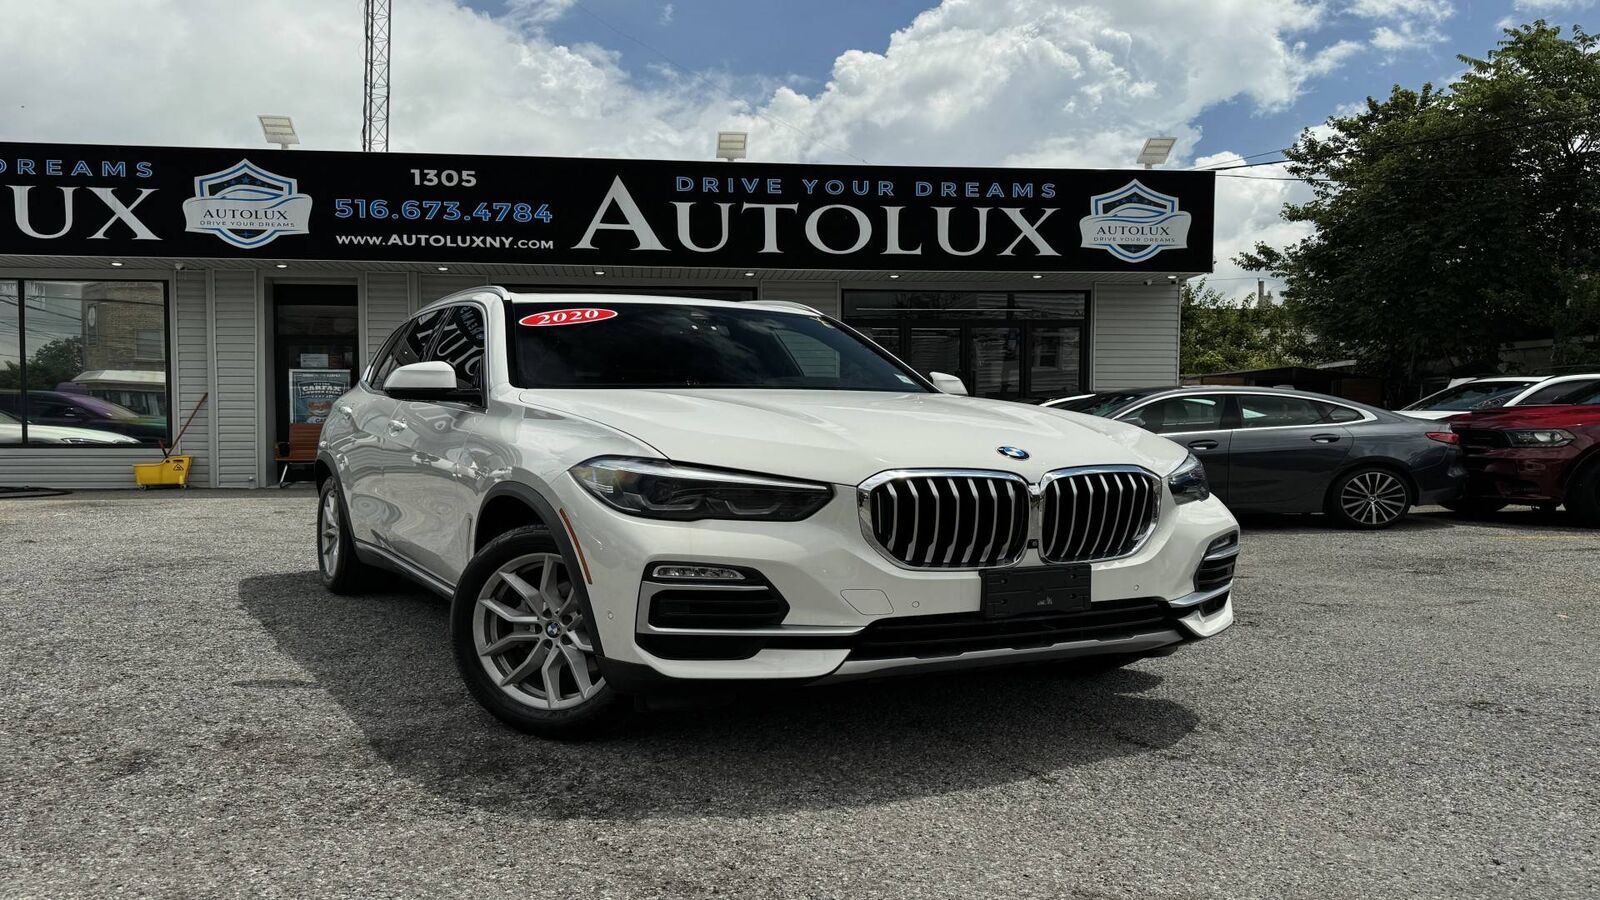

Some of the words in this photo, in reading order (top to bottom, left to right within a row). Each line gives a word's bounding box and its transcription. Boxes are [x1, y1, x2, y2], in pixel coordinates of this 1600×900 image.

[410, 168, 477, 187] 1305
[676, 176, 782, 194] DRIVE
[802, 178, 894, 196] YOUR
[915, 181, 1056, 199] DREAMS
[5, 184, 164, 241] UX
[203, 208, 289, 220] AUTOLUX
[334, 198, 553, 223] 516.673.4784
[570, 174, 1063, 256] AUTOLUX
[1096, 225, 1170, 236] AUTOLUX
[335, 233, 554, 250] WWW.AUTOLUXNY.COM
[537, 309, 599, 325] 2020
